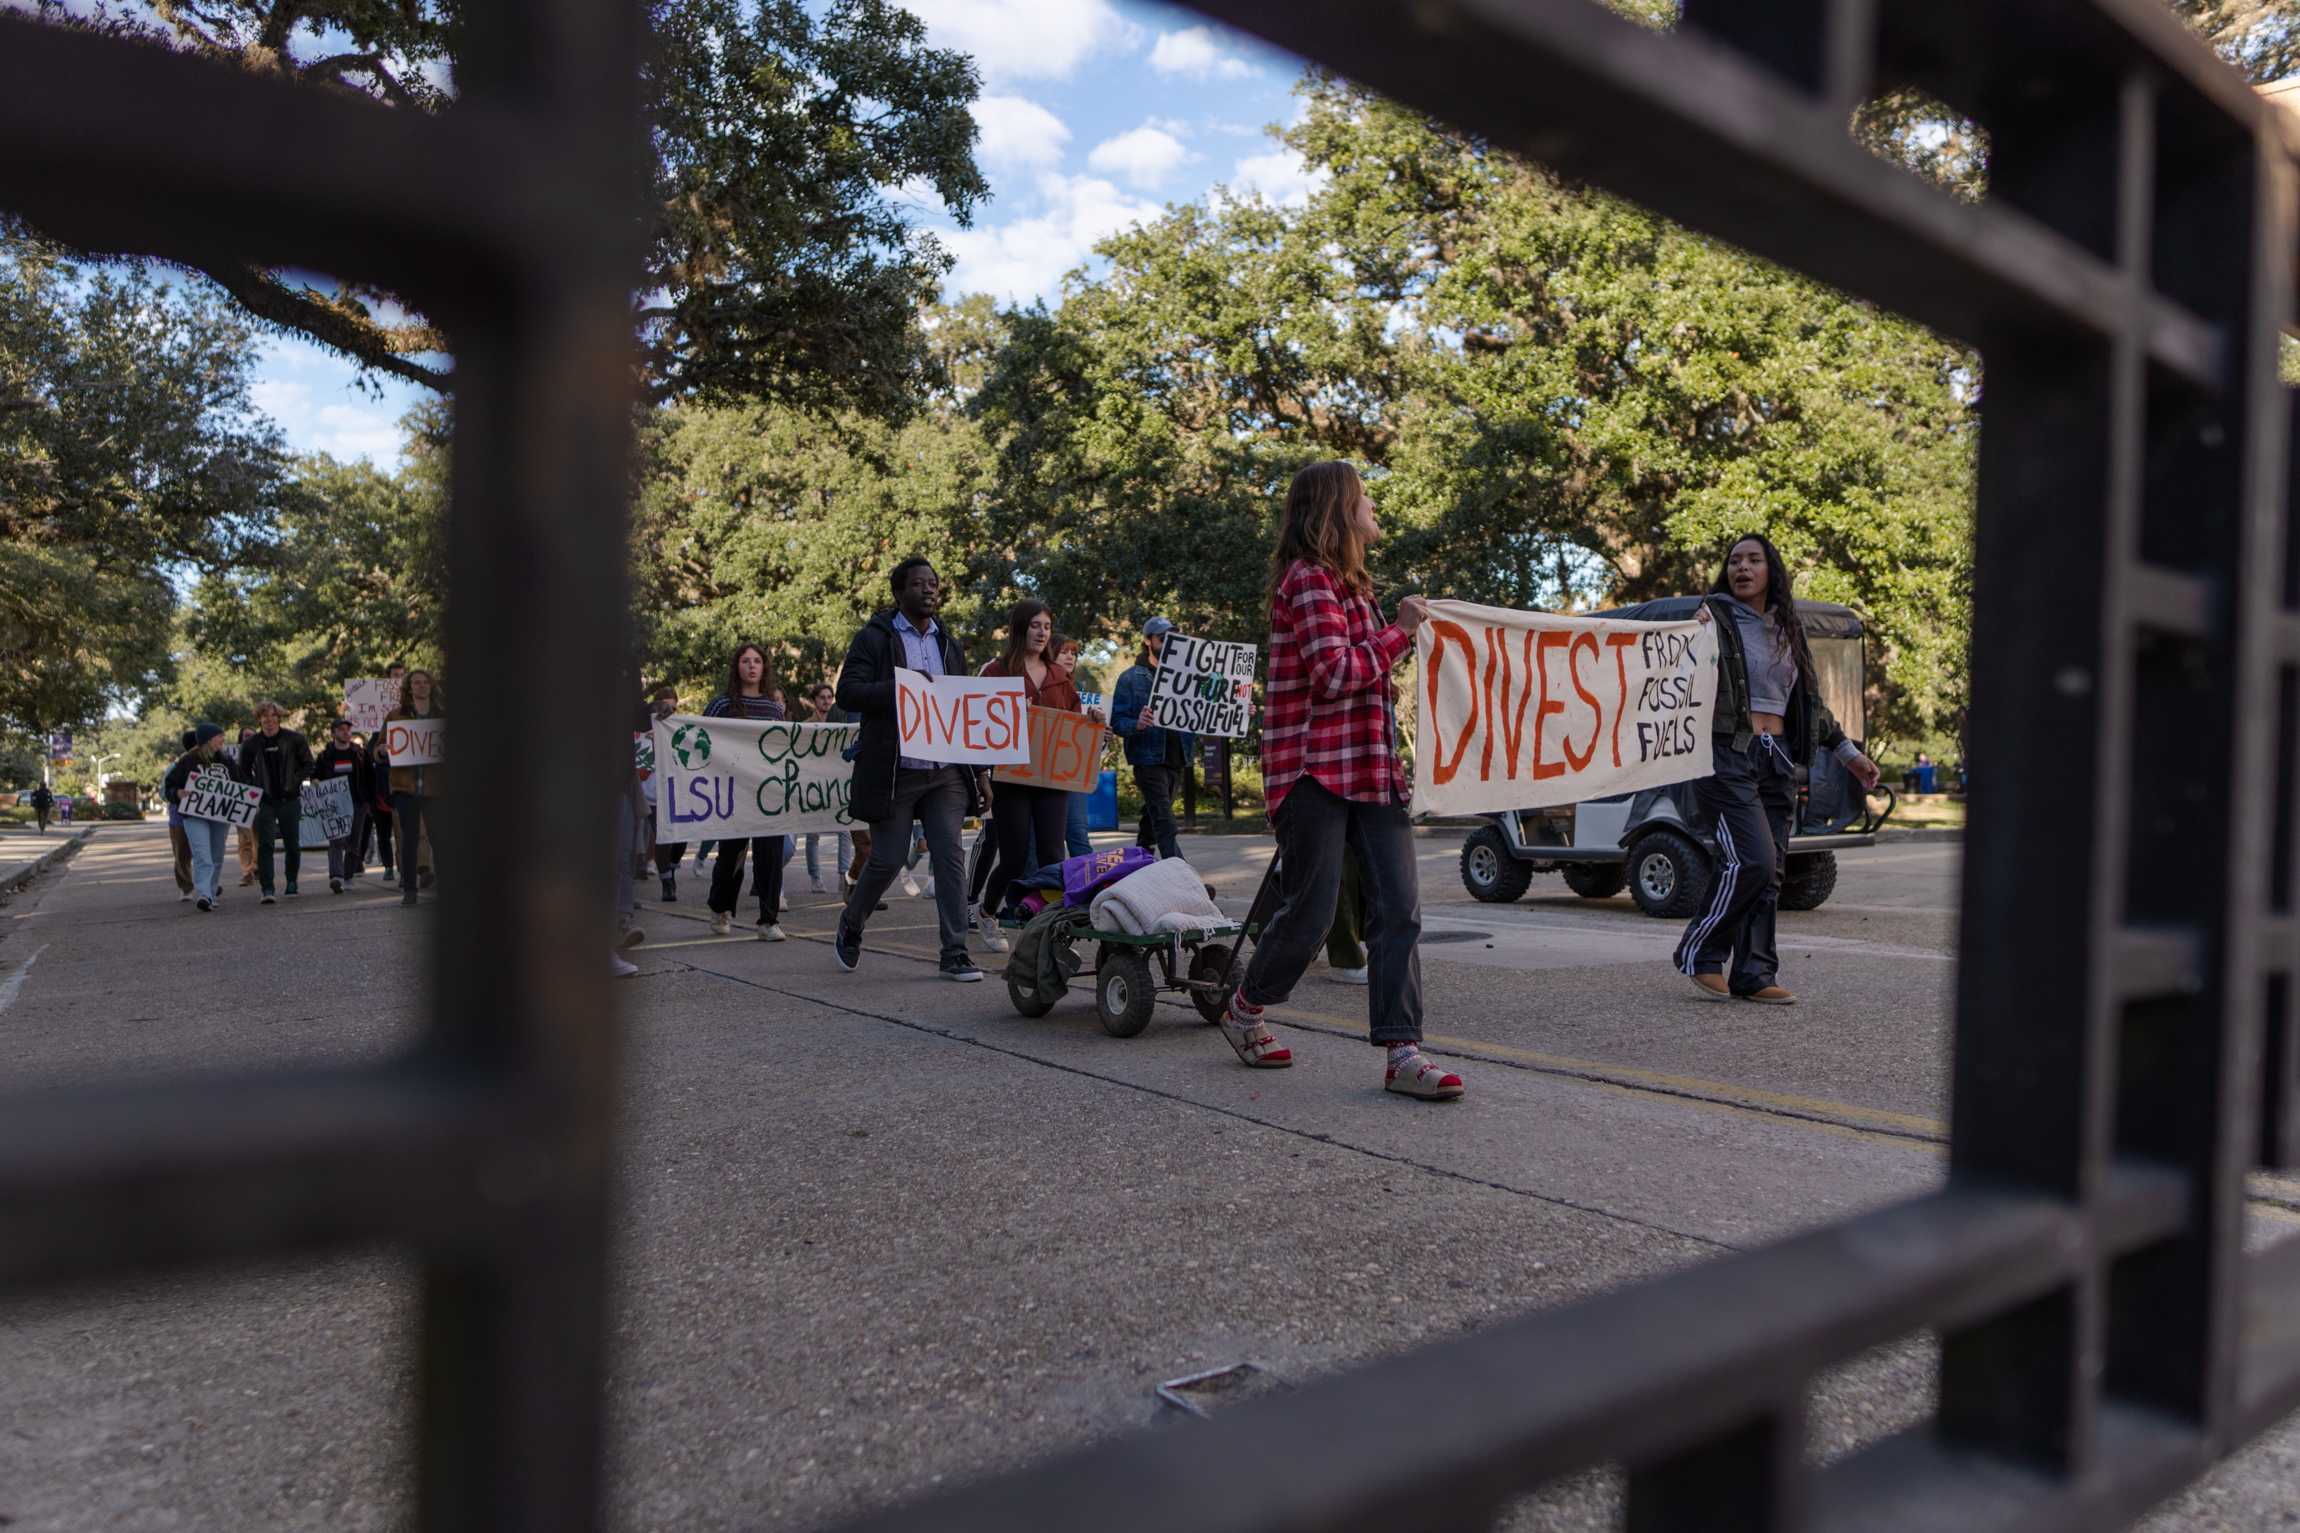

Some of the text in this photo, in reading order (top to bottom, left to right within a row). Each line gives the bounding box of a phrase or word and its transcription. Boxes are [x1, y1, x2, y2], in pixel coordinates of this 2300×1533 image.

[1161, 634, 1254, 675] FIGHT FOR
[1236, 664, 1253, 676] OUR
[375, 679, 400, 691] FOSS
[1080, 692, 1102, 704] ERE
[1153, 666, 1252, 704] FUTURE NOT
[1428, 620, 1638, 785] DIVEST
[1638, 674, 1702, 712] FOSSIL
[900, 684, 1025, 752] DIVEST
[1151, 695, 1216, 734] FOSSIL
[758, 721, 860, 764] Clim
[999, 706, 1105, 789] IVEST
[1637, 716, 1696, 762] FUELS
[183, 791, 257, 823] PLANET
[195, 776, 249, 801] GEAUX
[667, 776, 735, 823] LSU
[756, 758, 854, 825] Chang
